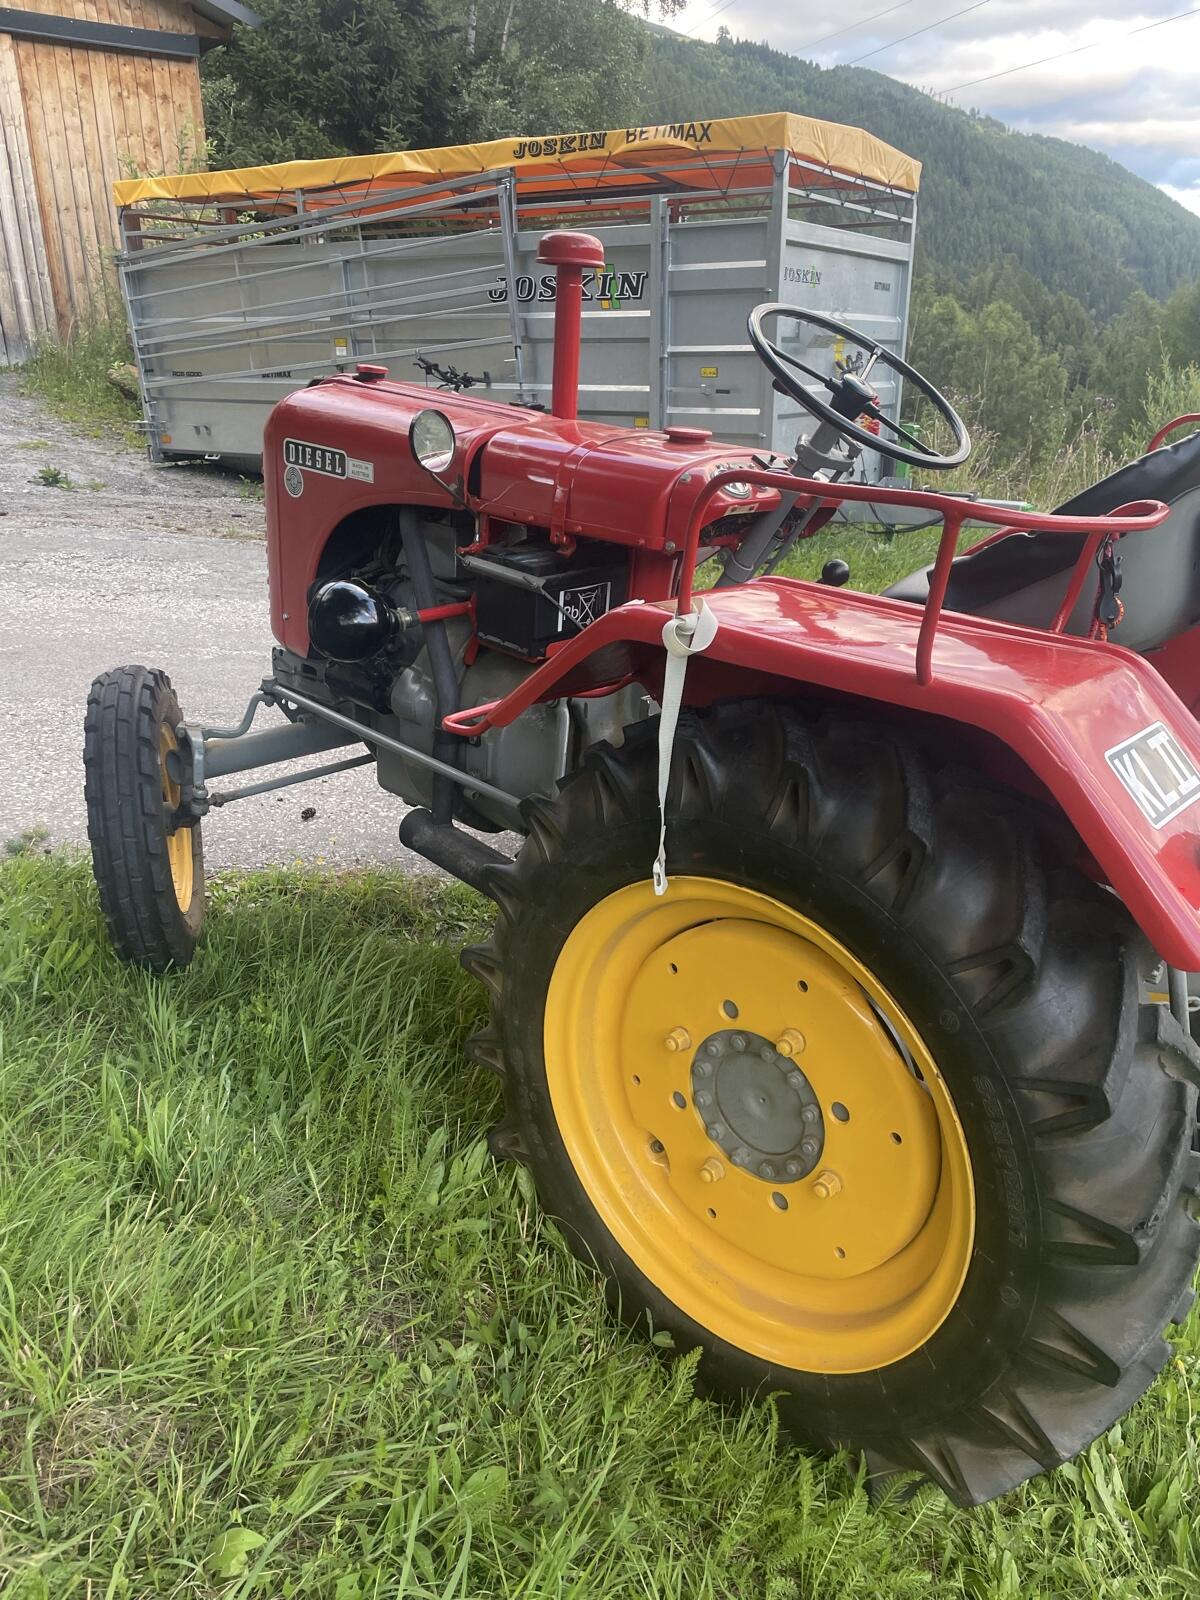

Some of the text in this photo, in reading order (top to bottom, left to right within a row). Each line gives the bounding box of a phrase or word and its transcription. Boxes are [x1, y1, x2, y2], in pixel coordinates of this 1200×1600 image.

[513, 131, 608, 160] JOSKIN
[783, 266, 822, 285] JOSKIN
[289, 443, 342, 474] DIESEL
